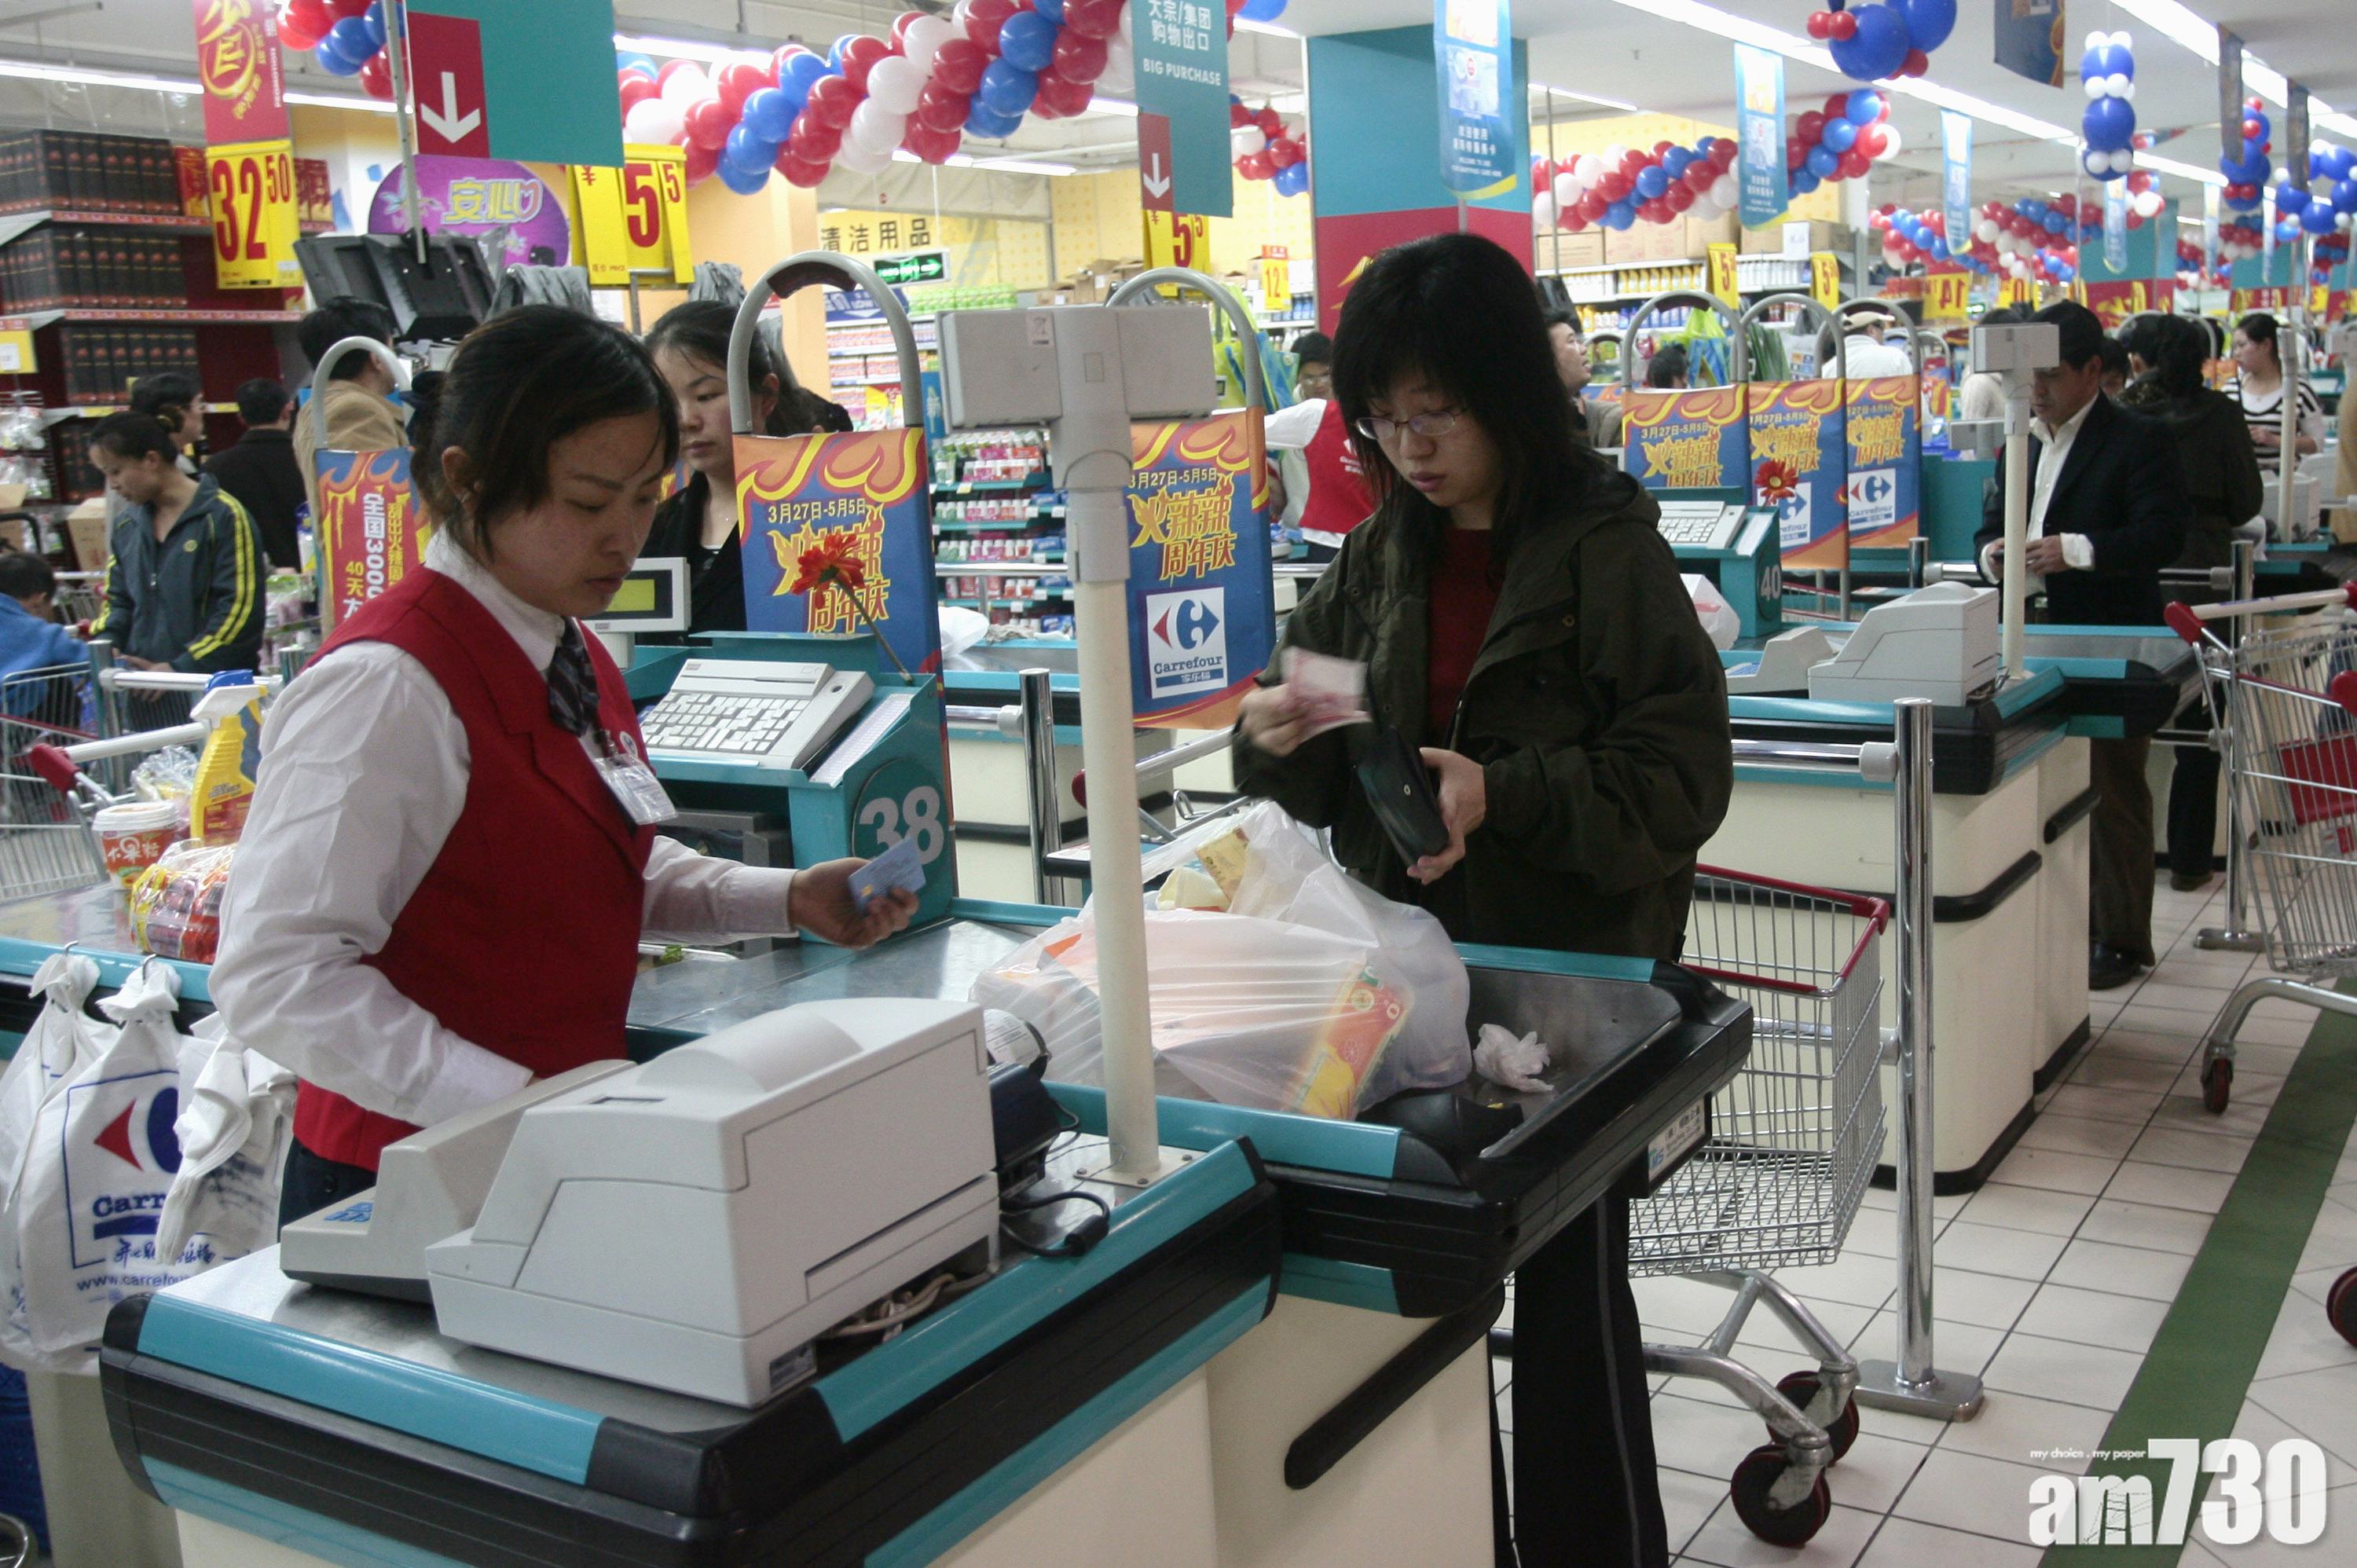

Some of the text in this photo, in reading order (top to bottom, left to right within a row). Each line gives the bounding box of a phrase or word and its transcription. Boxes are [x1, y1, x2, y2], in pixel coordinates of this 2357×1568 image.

[1151, 20, 1209, 51] 购物出口
[1143, 58, 1221, 86] BIG PURCHASE
[212, 153, 291, 262] 32 50
[625, 163, 660, 247] 5
[663, 163, 680, 203] 5
[820, 218, 930, 252] 清洁用品
[1173, 212, 1191, 267] 5
[1640, 422, 1709, 439] 3月27日-5月5日
[1128, 467, 1217, 489] 3月27日-5月5日
[768, 498, 866, 524] 3月27日-5月5日
[1127, 471, 1234, 548] 火辣辣
[1160, 533, 1237, 581] 周年庆
[1761, 565, 1781, 601] 40
[808, 577, 891, 635] 周年庆
[1153, 655, 1222, 675] Carrefour
[860, 786, 944, 865] 38
